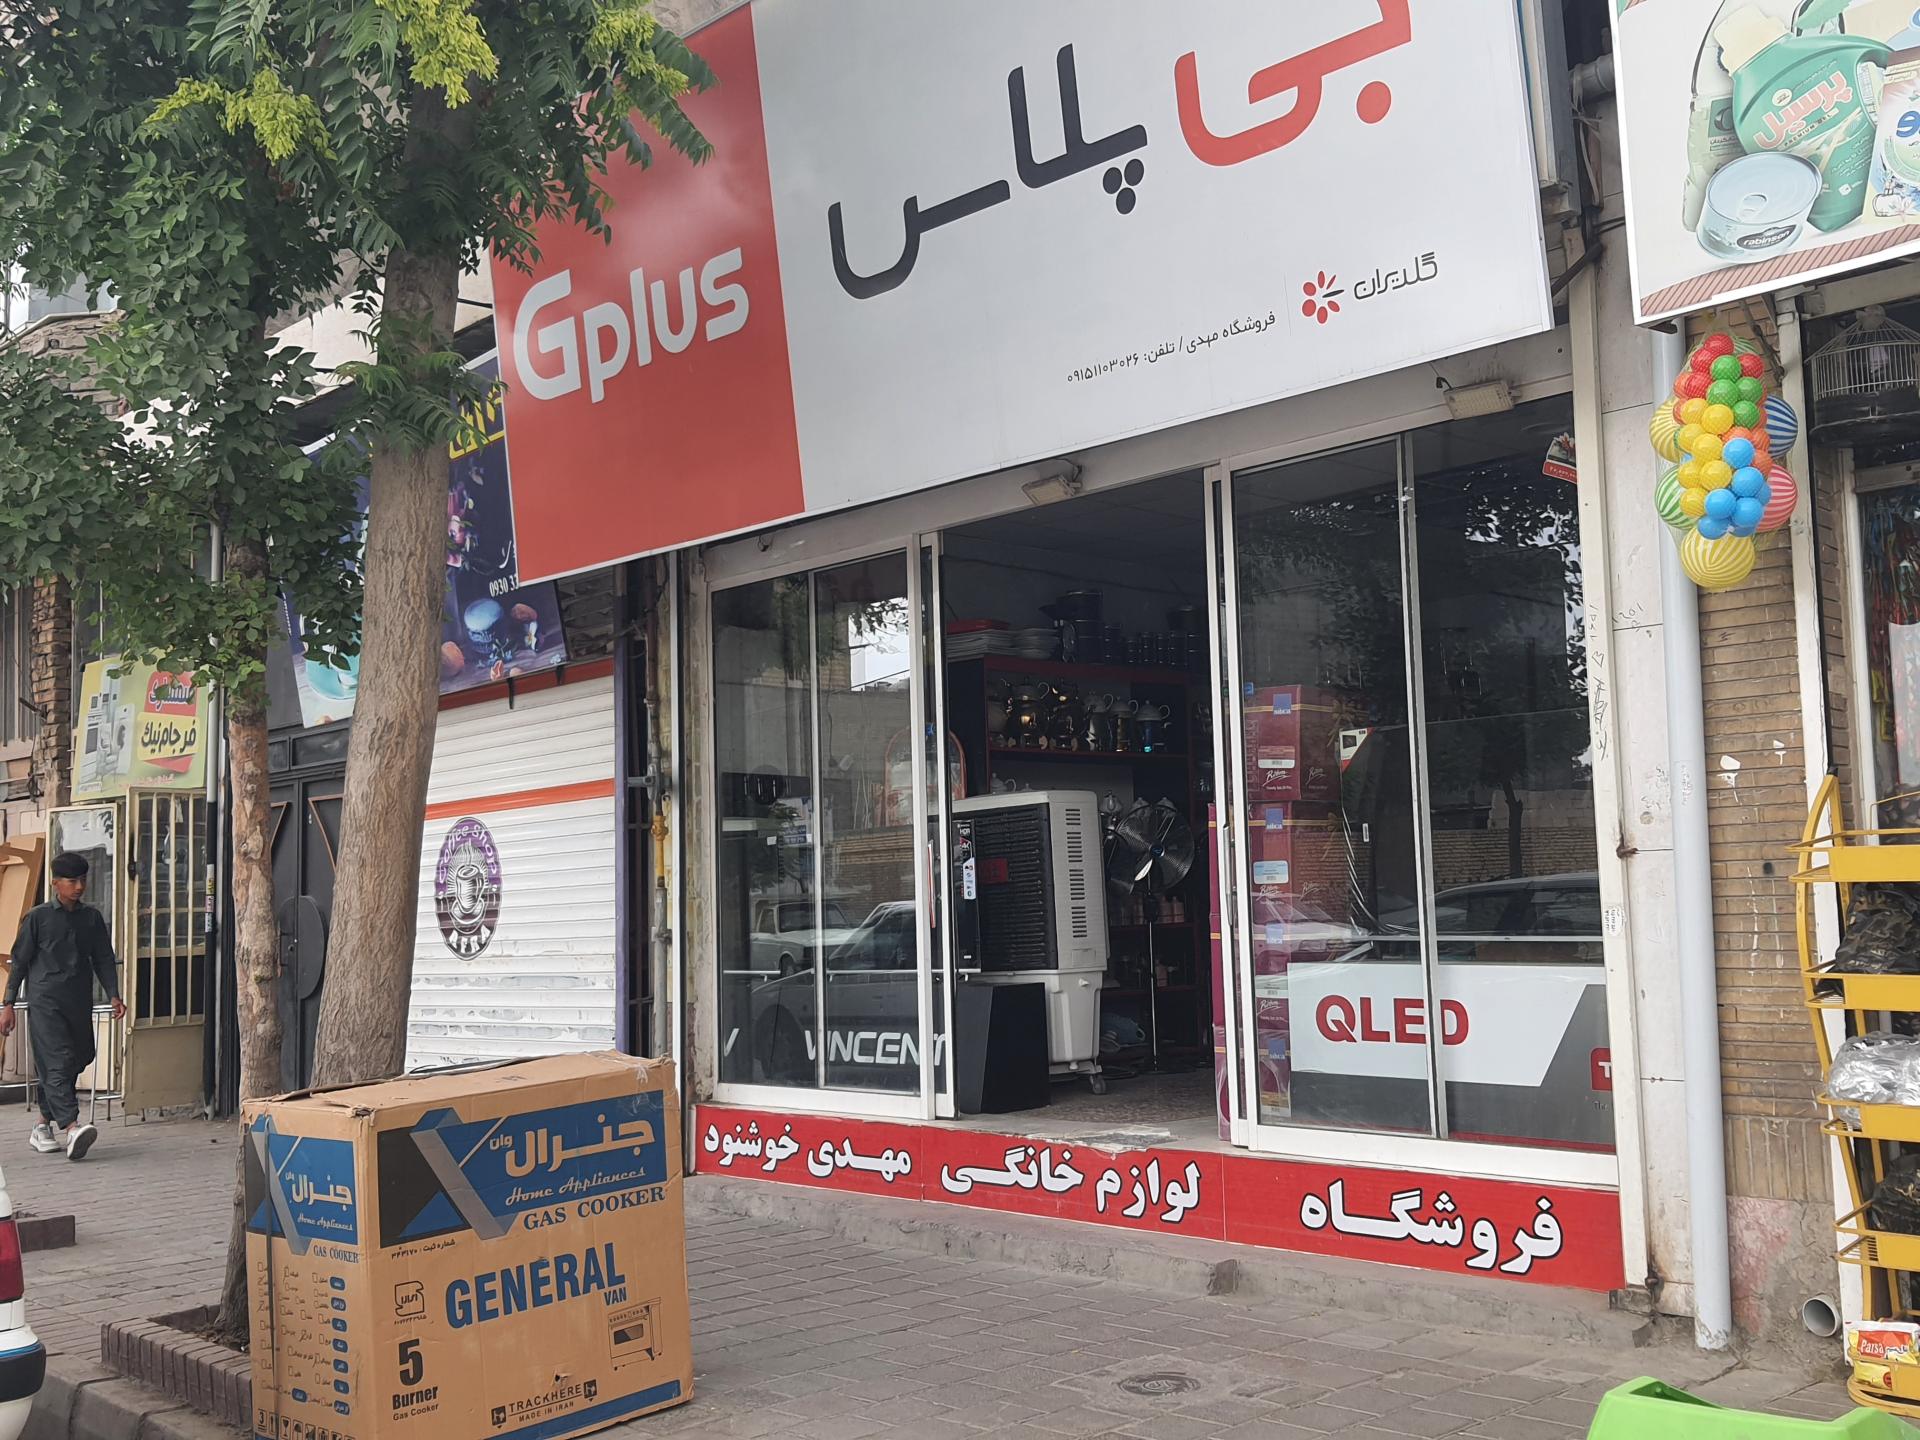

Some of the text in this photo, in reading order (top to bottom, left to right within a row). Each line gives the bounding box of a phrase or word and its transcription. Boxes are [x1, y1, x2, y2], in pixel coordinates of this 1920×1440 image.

[828, 43, 1148, 300] پلاس
[513, 247, 750, 404] Gplus
[1185, 331, 1219, 353] مهدی
[1222, 310, 1276, 339] فروشگاه
[1315, 994, 1469, 1046] QLED
[505, 1114, 656, 1178] جنرال
[291, 1174, 353, 1212] جنرال
[505, 1166, 647, 1206] Home Appliances
[702, 1119, 1564, 1275] فروشگاه لوازم خانگی مهدی خوشنود
[523, 1186, 666, 1230] GAS COOKER
[313, 1244, 359, 1264] GAS COOKER
[445, 1242, 627, 1330] GENERAL VAN
[398, 1338, 424, 1387] 5
[1860, 1339, 1884, 1354] Parsa
[392, 1386, 439, 1410] Burner
[392, 1402, 439, 1421] Gas Cooker
[518, 1410, 542, 1423] MADE
